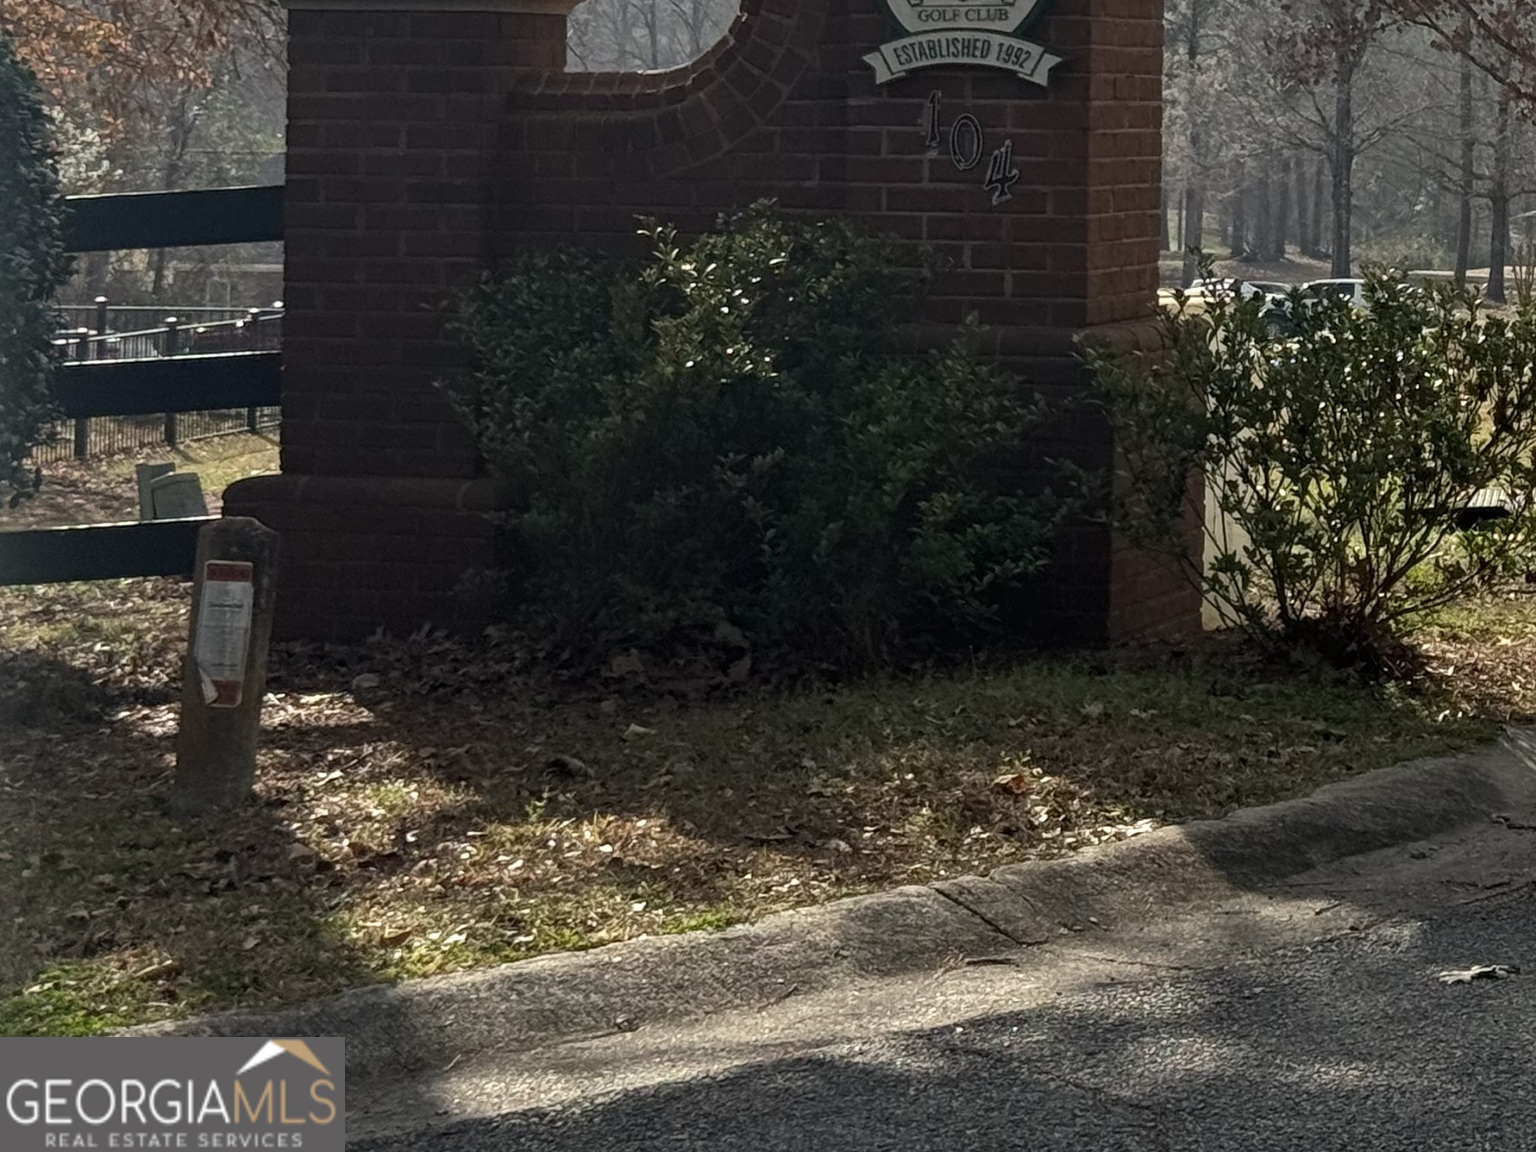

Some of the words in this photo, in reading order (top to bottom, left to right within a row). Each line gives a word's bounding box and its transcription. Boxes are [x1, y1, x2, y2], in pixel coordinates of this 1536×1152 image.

[917, 9, 961, 23] GOLF
[964, 9, 1010, 23] CLUB
[892, 36, 991, 66] ESTABLISHED
[996, 42, 1033, 70] 1992
[925, 89, 1020, 206] 104
